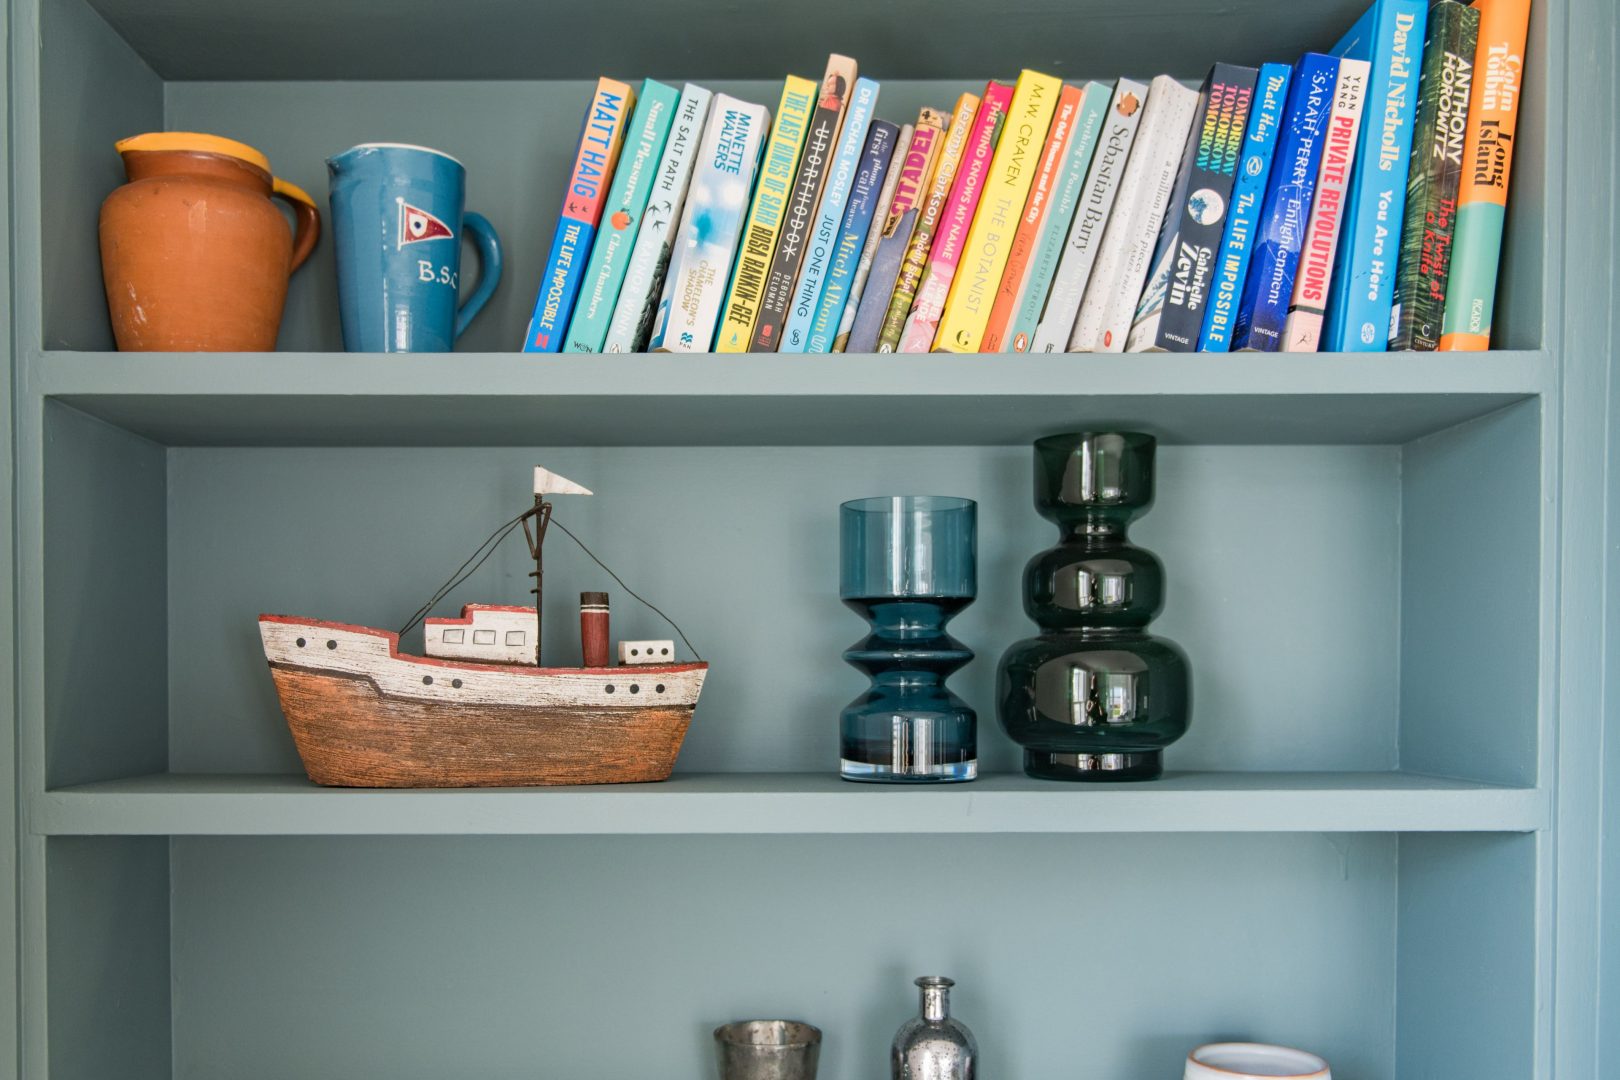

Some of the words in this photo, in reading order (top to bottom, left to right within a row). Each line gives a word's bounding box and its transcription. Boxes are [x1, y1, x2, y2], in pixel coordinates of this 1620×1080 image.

[1390, 12, 1415, 78] David
[859, 88, 872, 105] DR
[1024, 84, 1045, 119] M.W.
[1264, 76, 1284, 110] Matt
[1338, 76, 1351, 108] YANG
[1348, 76, 1361, 110] YUAN
[1500, 54, 1522, 112] Colm
[588, 92, 622, 149] MATT
[643, 100, 664, 140] Small
[683, 98, 698, 122] THE
[784, 92, 808, 113] THE
[987, 101, 1002, 124] THE
[1059, 102, 1073, 121] The
[1303, 75, 1326, 132] SARAH
[1433, 52, 1457, 160] HOROWITZ
[1446, 57, 1472, 166] ANTHONY
[673, 125, 690, 156] SALT
[714, 110, 738, 171] WALTERS
[727, 113, 752, 176] MINETTE
[777, 112, 803, 144] LAST
[844, 108, 866, 156] MICHAEL
[870, 128, 888, 156] first
[946, 104, 974, 160] Jeremy
[976, 124, 994, 158] WIND
[1053, 119, 1068, 140] Odd
[1074, 110, 1098, 158] Anything
[1196, 83, 1224, 172] TOMORROW
[1210, 85, 1238, 174] TOMORROW
[1222, 88, 1252, 177] TOMORROW
[1250, 112, 1275, 143] Haig
[1379, 82, 1407, 172] Nicholls
[768, 142, 795, 178] KINGS
[880, 141, 888, 152] the
[1005, 124, 1032, 186] CRAVEN
[1042, 139, 1061, 173] Woman
[1292, 136, 1312, 188] PERRY
[1322, 116, 1354, 185] PRIVATE
[1474, 120, 1500, 187] Island
[1494, 119, 1512, 190] Long
[574, 150, 606, 198] HAIG
[623, 141, 651, 205] Pleasures
[662, 159, 678, 191] PATH
[832, 158, 850, 207] MOSLEY
[857, 170, 870, 197] call
[870, 158, 882, 186] phone
[890, 128, 934, 215] CITADEL
[960, 159, 983, 204] KNOWS
[1037, 172, 1050, 191] and
[1090, 124, 1129, 209] Sebastian
[764, 177, 786, 195] OF
[782, 122, 830, 260] UNORTHODOX
[924, 161, 954, 226] Clarkson
[1031, 190, 1045, 208] the
[1060, 170, 1079, 216] Possible
[1154, 169, 1170, 208] million
[1237, 194, 1254, 214] The
[846, 199, 861, 229] heaven
[954, 204, 968, 223] MY
[991, 198, 1012, 228] THE
[1024, 205, 1040, 225] City
[1376, 190, 1393, 222] You
[1426, 212, 1435, 224] a
[1438, 198, 1455, 228] The
[564, 224, 580, 245] THE
[747, 225, 773, 258] ROSA
[820, 215, 834, 244] JUST
[942, 224, 962, 260] NAME
[1072, 207, 1102, 255] Barry
[1144, 211, 1160, 239] little
[1230, 218, 1249, 251] LIFE
[1373, 224, 1388, 256] Are
[558, 246, 574, 268] LIFE
[605, 234, 621, 261] Clare
[809, 248, 824, 276] ONE
[832, 232, 858, 278] Mitch
[911, 232, 928, 264] Diddly
[1128, 243, 1139, 272] JAMES
[1135, 240, 1148, 273] pieces
[1268, 198, 1300, 306] Enlightenment
[1302, 188, 1341, 300] REVOLUTIONS
[1420, 229, 1436, 274] Knife
[1433, 234, 1450, 277] Twist
[631, 241, 653, 293] RAYNOR
[705, 268, 716, 286] THE
[904, 264, 918, 293] Squat
[966, 232, 1000, 315] BOTANIST
[1170, 242, 1200, 306] Zevin
[1188, 247, 1212, 310] Gabrielle
[1368, 260, 1385, 302] Here
[540, 268, 568, 330] IMPOSSIBLE
[587, 264, 611, 318] Chambers
[682, 269, 696, 312] SHADOW
[729, 257, 764, 327] RANKIN-GEE
[765, 272, 781, 310] FELDMAN
[775, 274, 792, 312] DEBORAH
[798, 278, 816, 317] THING
[816, 280, 842, 332] Albom
[916, 273, 938, 322] ALLENDE
[929, 283, 946, 318] ISABEL
[1209, 254, 1240, 343] IMPOSSIBLE
[1430, 280, 1444, 302] of
[618, 299, 634, 336] WINN
[1254, 326, 1278, 338] VINTAGE
[679, 342, 691, 350] PAN
[1165, 332, 1188, 344] VINTAGE
